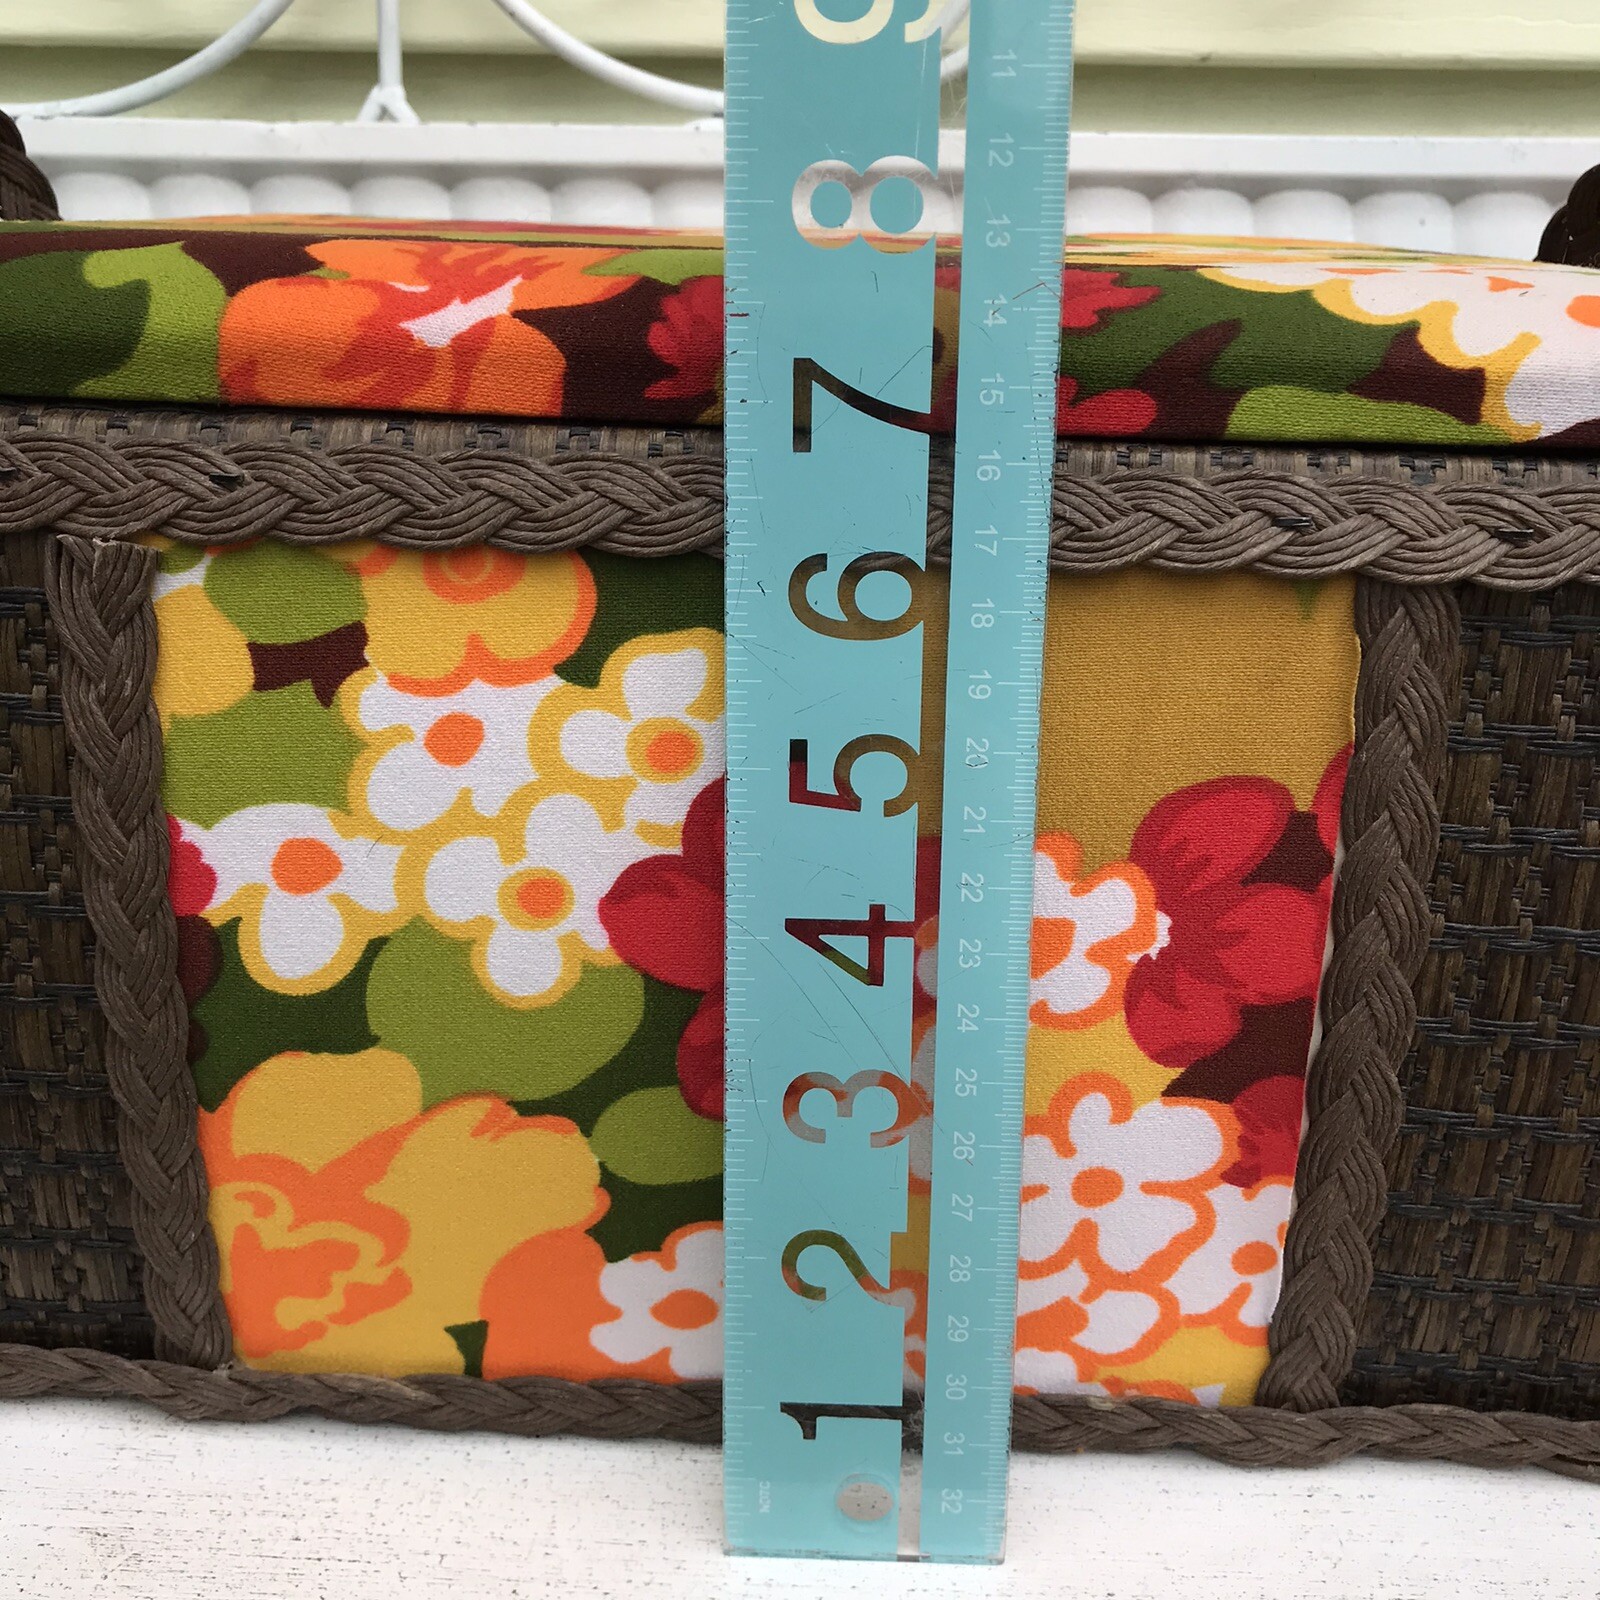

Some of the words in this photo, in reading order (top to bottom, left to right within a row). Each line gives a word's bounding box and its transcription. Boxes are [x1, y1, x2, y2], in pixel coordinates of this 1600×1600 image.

[991, 49, 1018, 78] 11
[988, 132, 1014, 168] 12
[791, 154, 938, 255] 8
[986, 214, 1011, 249] 13
[984, 293, 1007, 328] 14
[793, 357, 932, 453] 7
[980, 373, 1004, 406] 15
[977, 449, 1002, 482] 16
[974, 525, 998, 557] 17
[788, 551, 926, 642] 6
[970, 598, 995, 629] 18
[968, 669, 993, 700] 19
[966, 737, 990, 769] 20
[788, 733, 920, 818] 5
[963, 806, 987, 834] 21
[960, 872, 984, 904] 22
[785, 903, 915, 987] 4
[959, 938, 983, 969] 23
[957, 1003, 980, 1033] 24
[955, 1067, 978, 1098] 25
[782, 1069, 911, 1148] 3
[953, 1131, 976, 1160] 26
[951, 1193, 974, 1222] 27
[781, 1229, 906, 1308] 2
[949, 1254, 971, 1283] 28
[947, 1315, 970, 1343] 29
[945, 1373, 967, 1401] 30
[779, 1401, 903, 1440] 1
[943, 1432, 965, 1457] 31
[941, 1488, 963, 1515] 32
